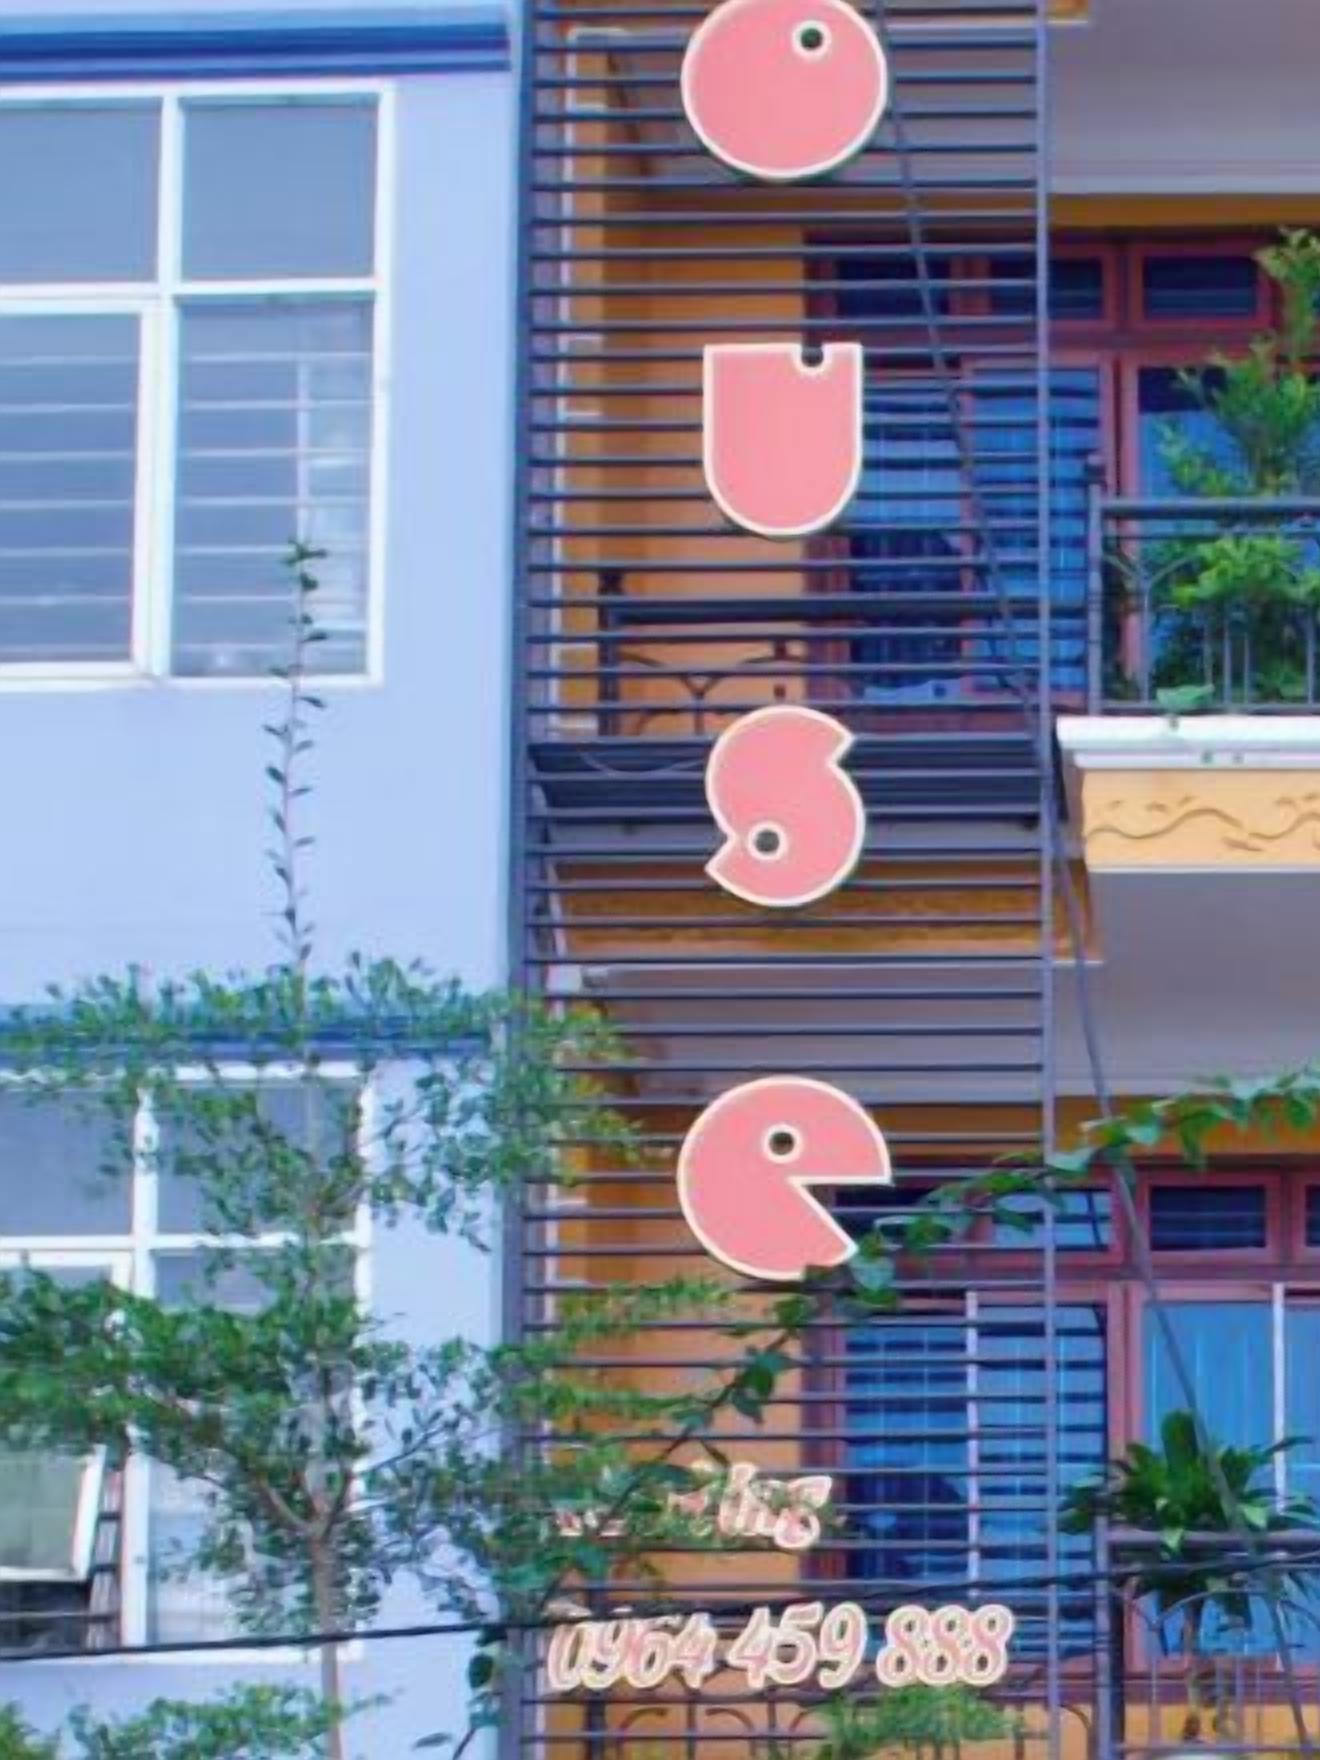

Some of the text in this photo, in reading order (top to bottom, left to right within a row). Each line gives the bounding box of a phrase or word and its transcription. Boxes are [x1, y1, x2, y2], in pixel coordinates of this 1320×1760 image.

[548, 1602, 1015, 1688] 0964 459 888
